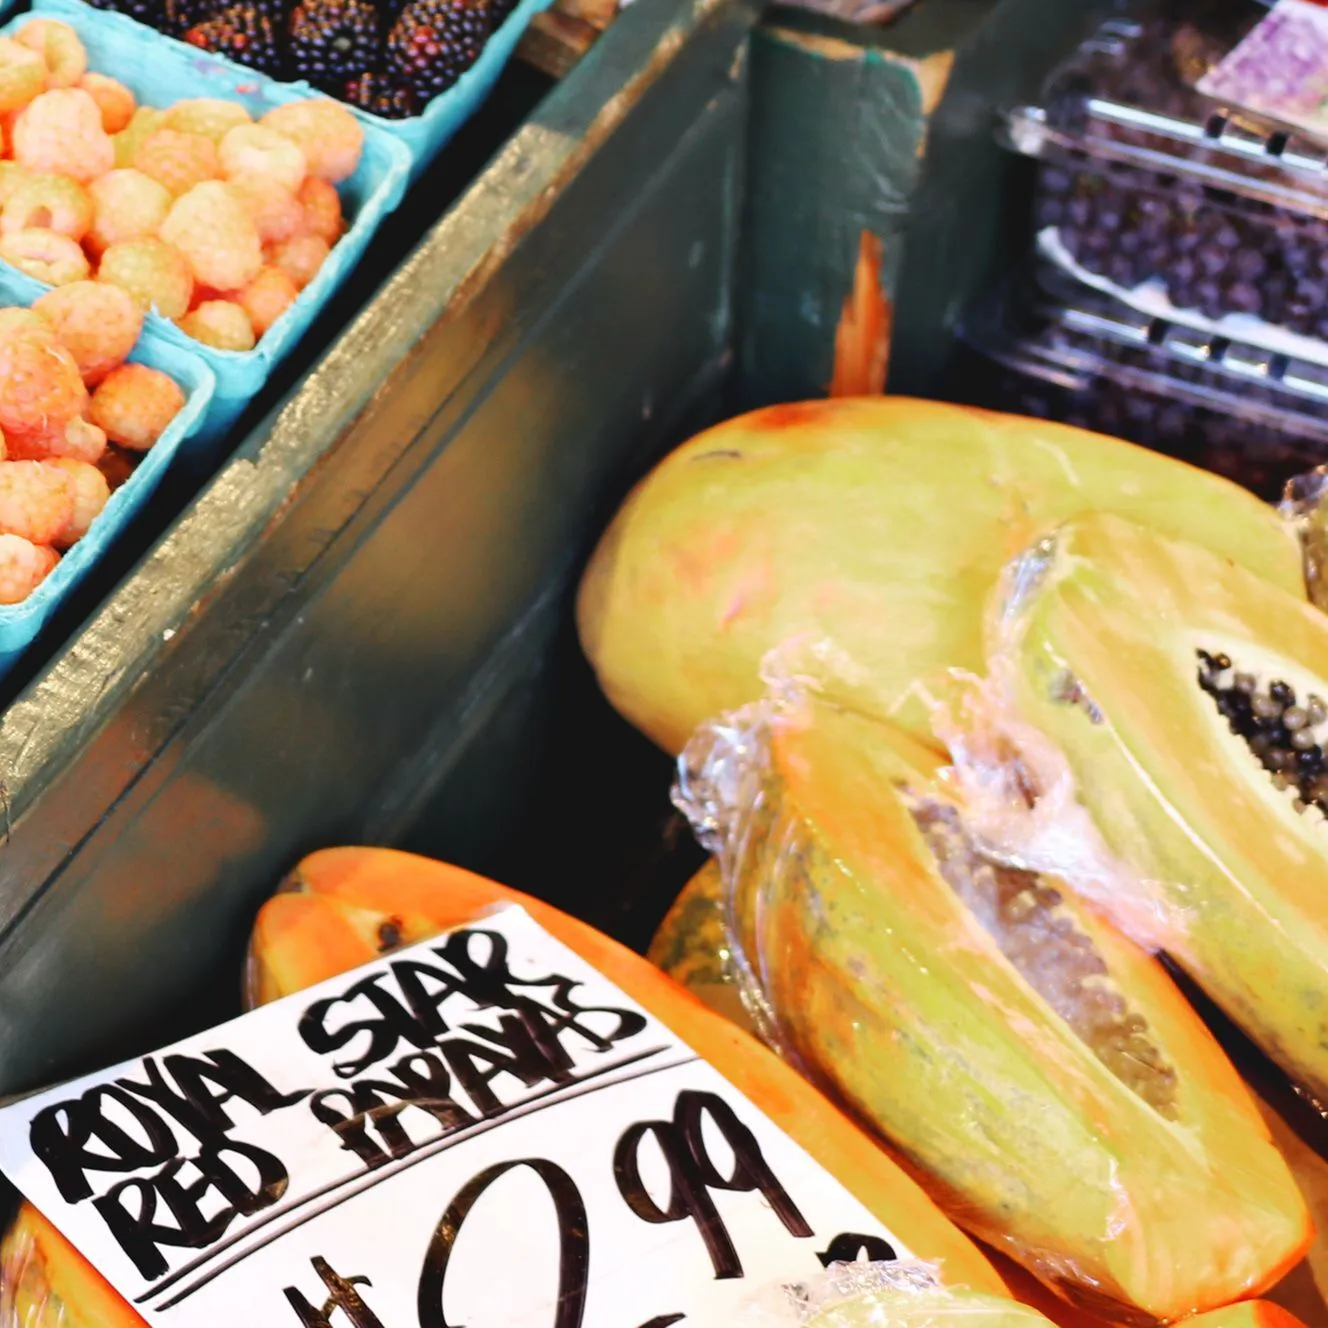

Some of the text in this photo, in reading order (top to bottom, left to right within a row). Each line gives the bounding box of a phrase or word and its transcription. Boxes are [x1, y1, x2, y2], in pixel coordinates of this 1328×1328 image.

[28, 927, 540, 1205] ROYAL STAR
[92, 1138, 290, 1283] RED
